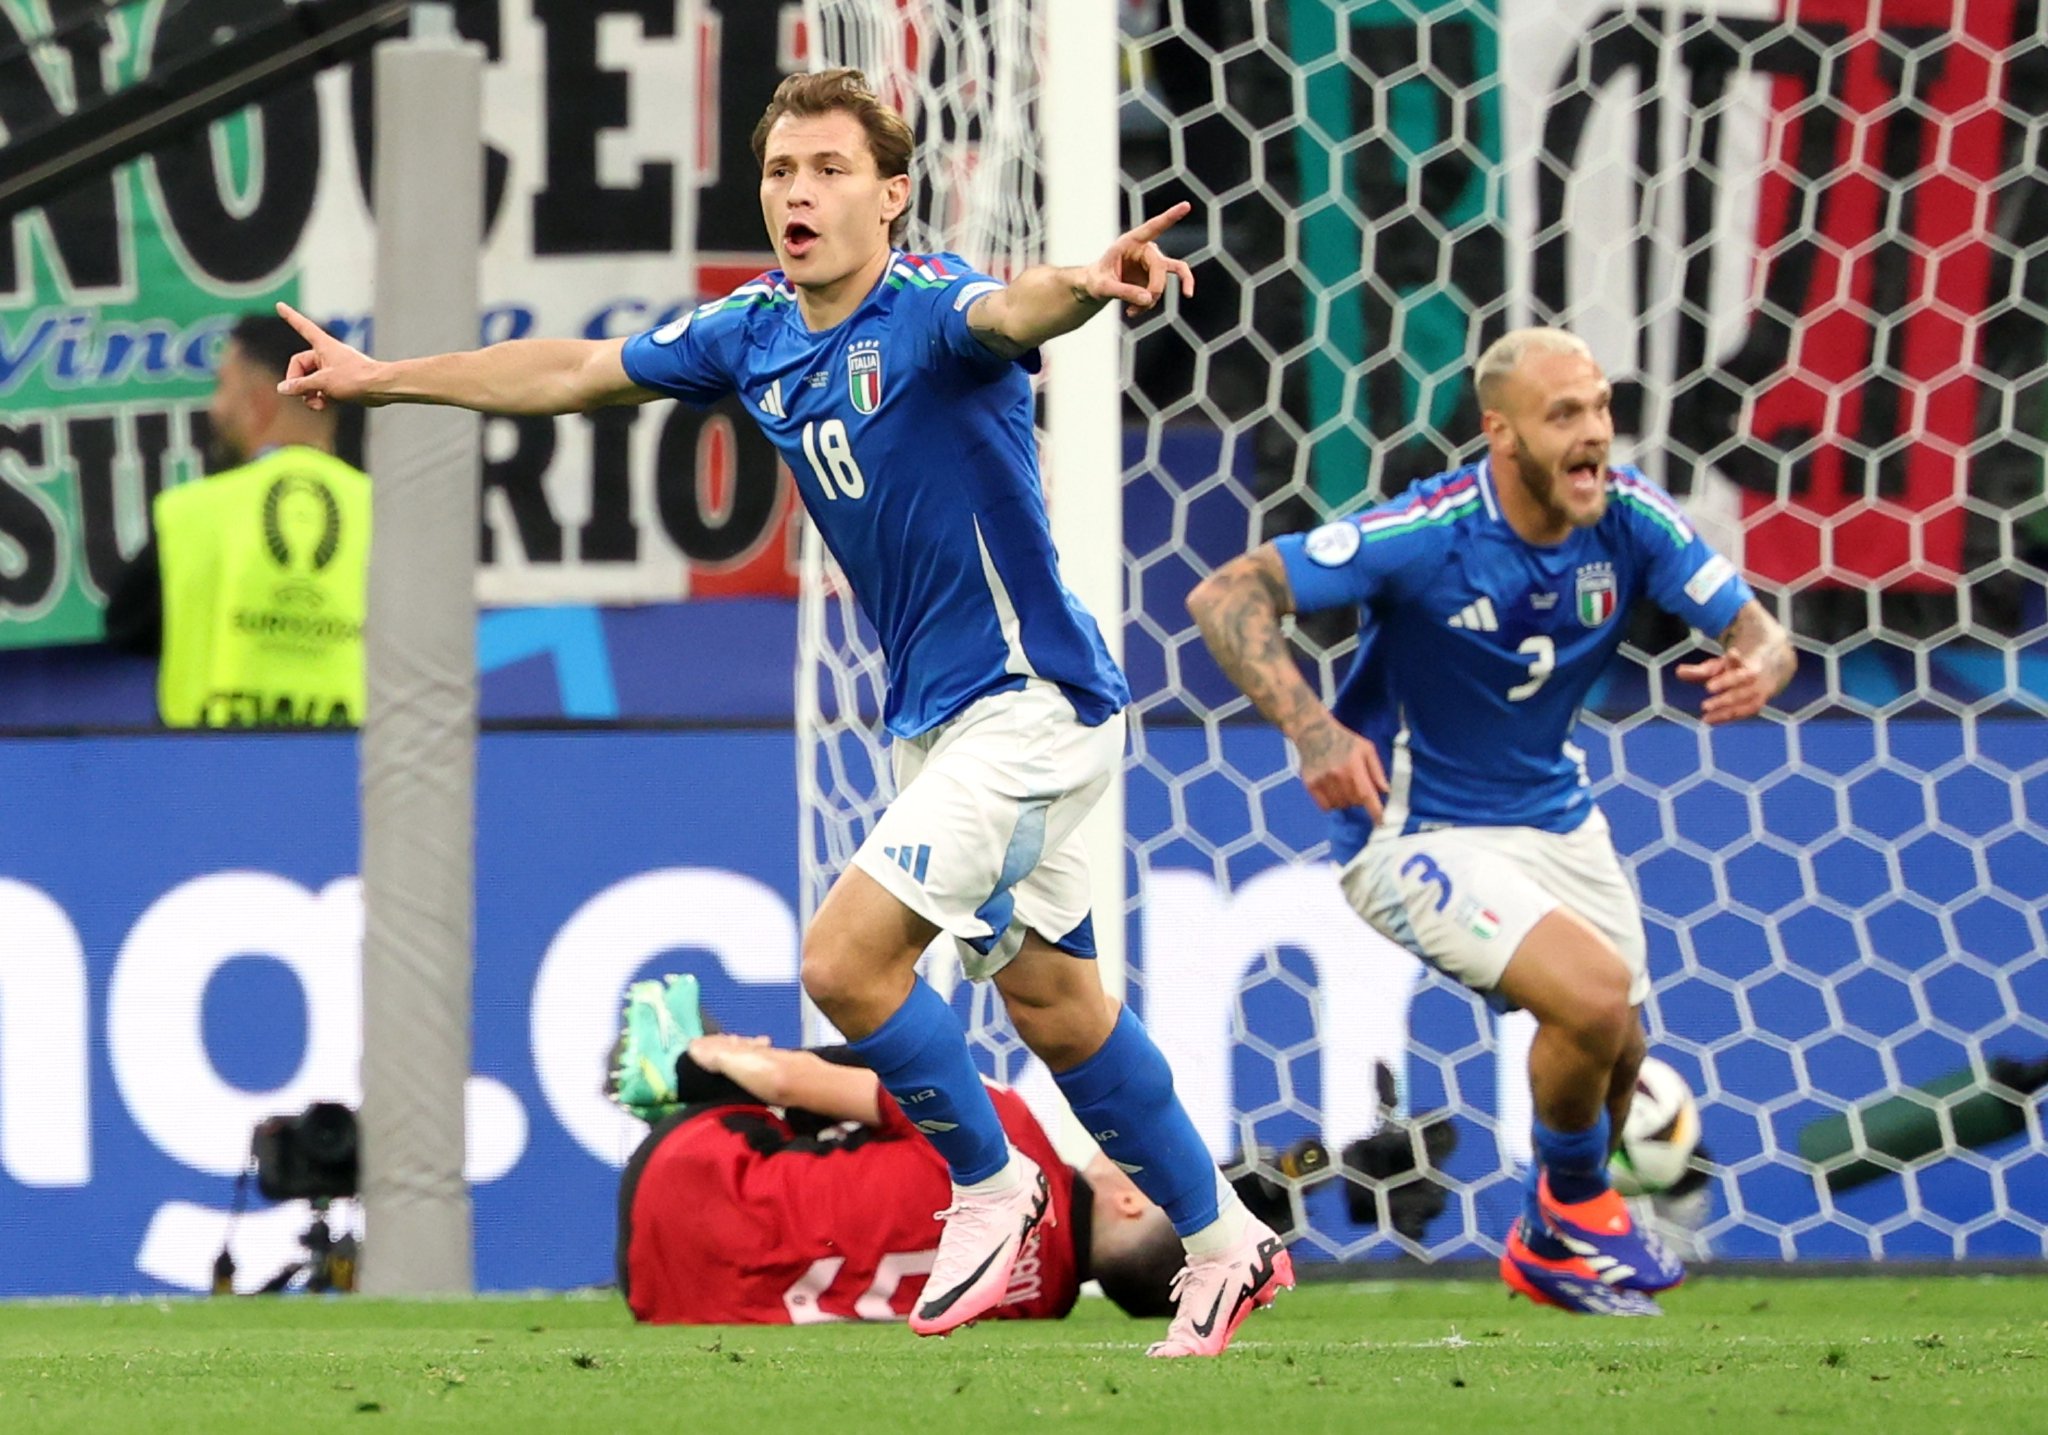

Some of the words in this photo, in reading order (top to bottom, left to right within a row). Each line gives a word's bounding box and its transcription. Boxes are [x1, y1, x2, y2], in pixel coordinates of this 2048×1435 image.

[850, 354, 877, 370] ITALIA
[803, 419, 865, 500] 18
[1507, 636, 1556, 701] 3
[1400, 853, 1453, 912] 3
